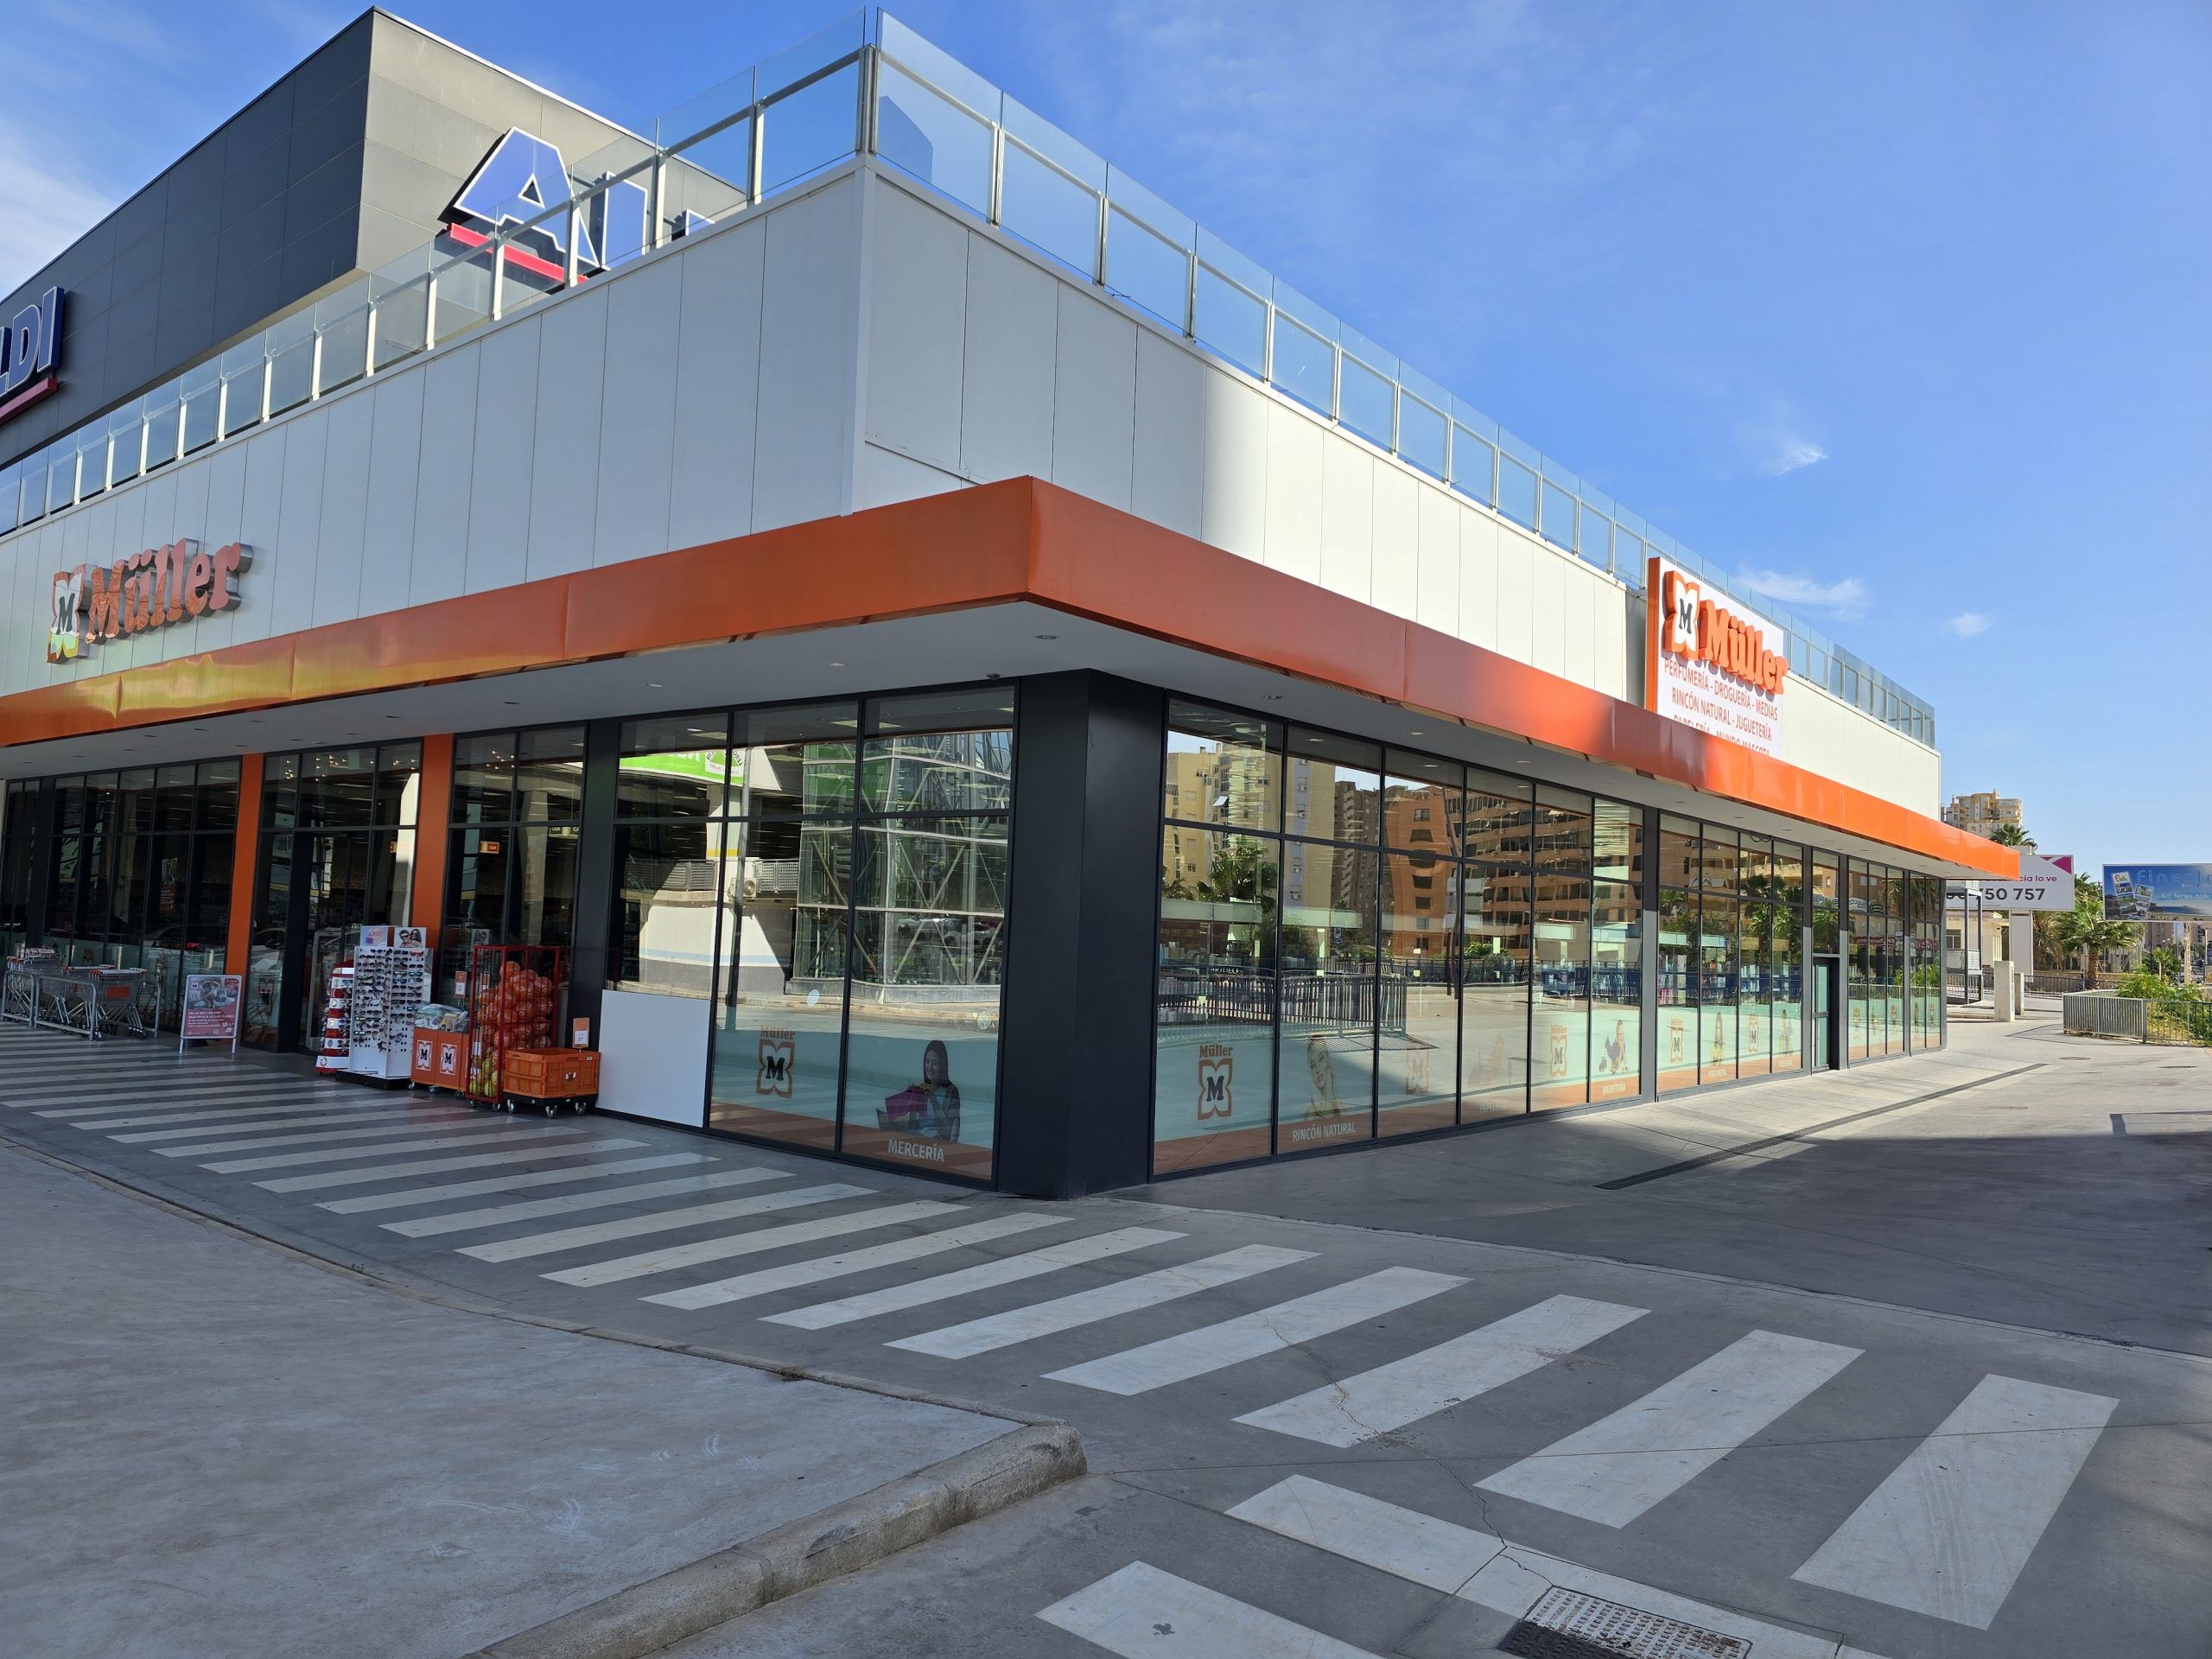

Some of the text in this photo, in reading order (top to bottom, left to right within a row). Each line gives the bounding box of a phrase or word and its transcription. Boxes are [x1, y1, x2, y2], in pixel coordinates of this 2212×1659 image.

[86, 537, 251, 645] Müller
[1679, 598, 1787, 695] M Müller
[1664, 658, 1709, 691] PERFUMERÍA
[1714, 680, 1751, 710] DROGUERÍA
[1755, 698, 1778, 721] MEDIAS
[1672, 687, 1700, 712] RINCÓN
[1700, 699, 1731, 725] NATURAL
[1736, 715, 1772, 741] JUGUETERÍA
[2013, 888, 2046, 900] 757
[421, 1048, 428, 1060] M
[445, 1052, 452, 1064] M
[1199, 1044, 1233, 1058] Müller
[766, 1056, 785, 1081] M
[1206, 1076, 1224, 1102] M
[1292, 1122, 1356, 1142] RINCÓN NATURAL
[887, 1139, 945, 1163] MERCERÍA
